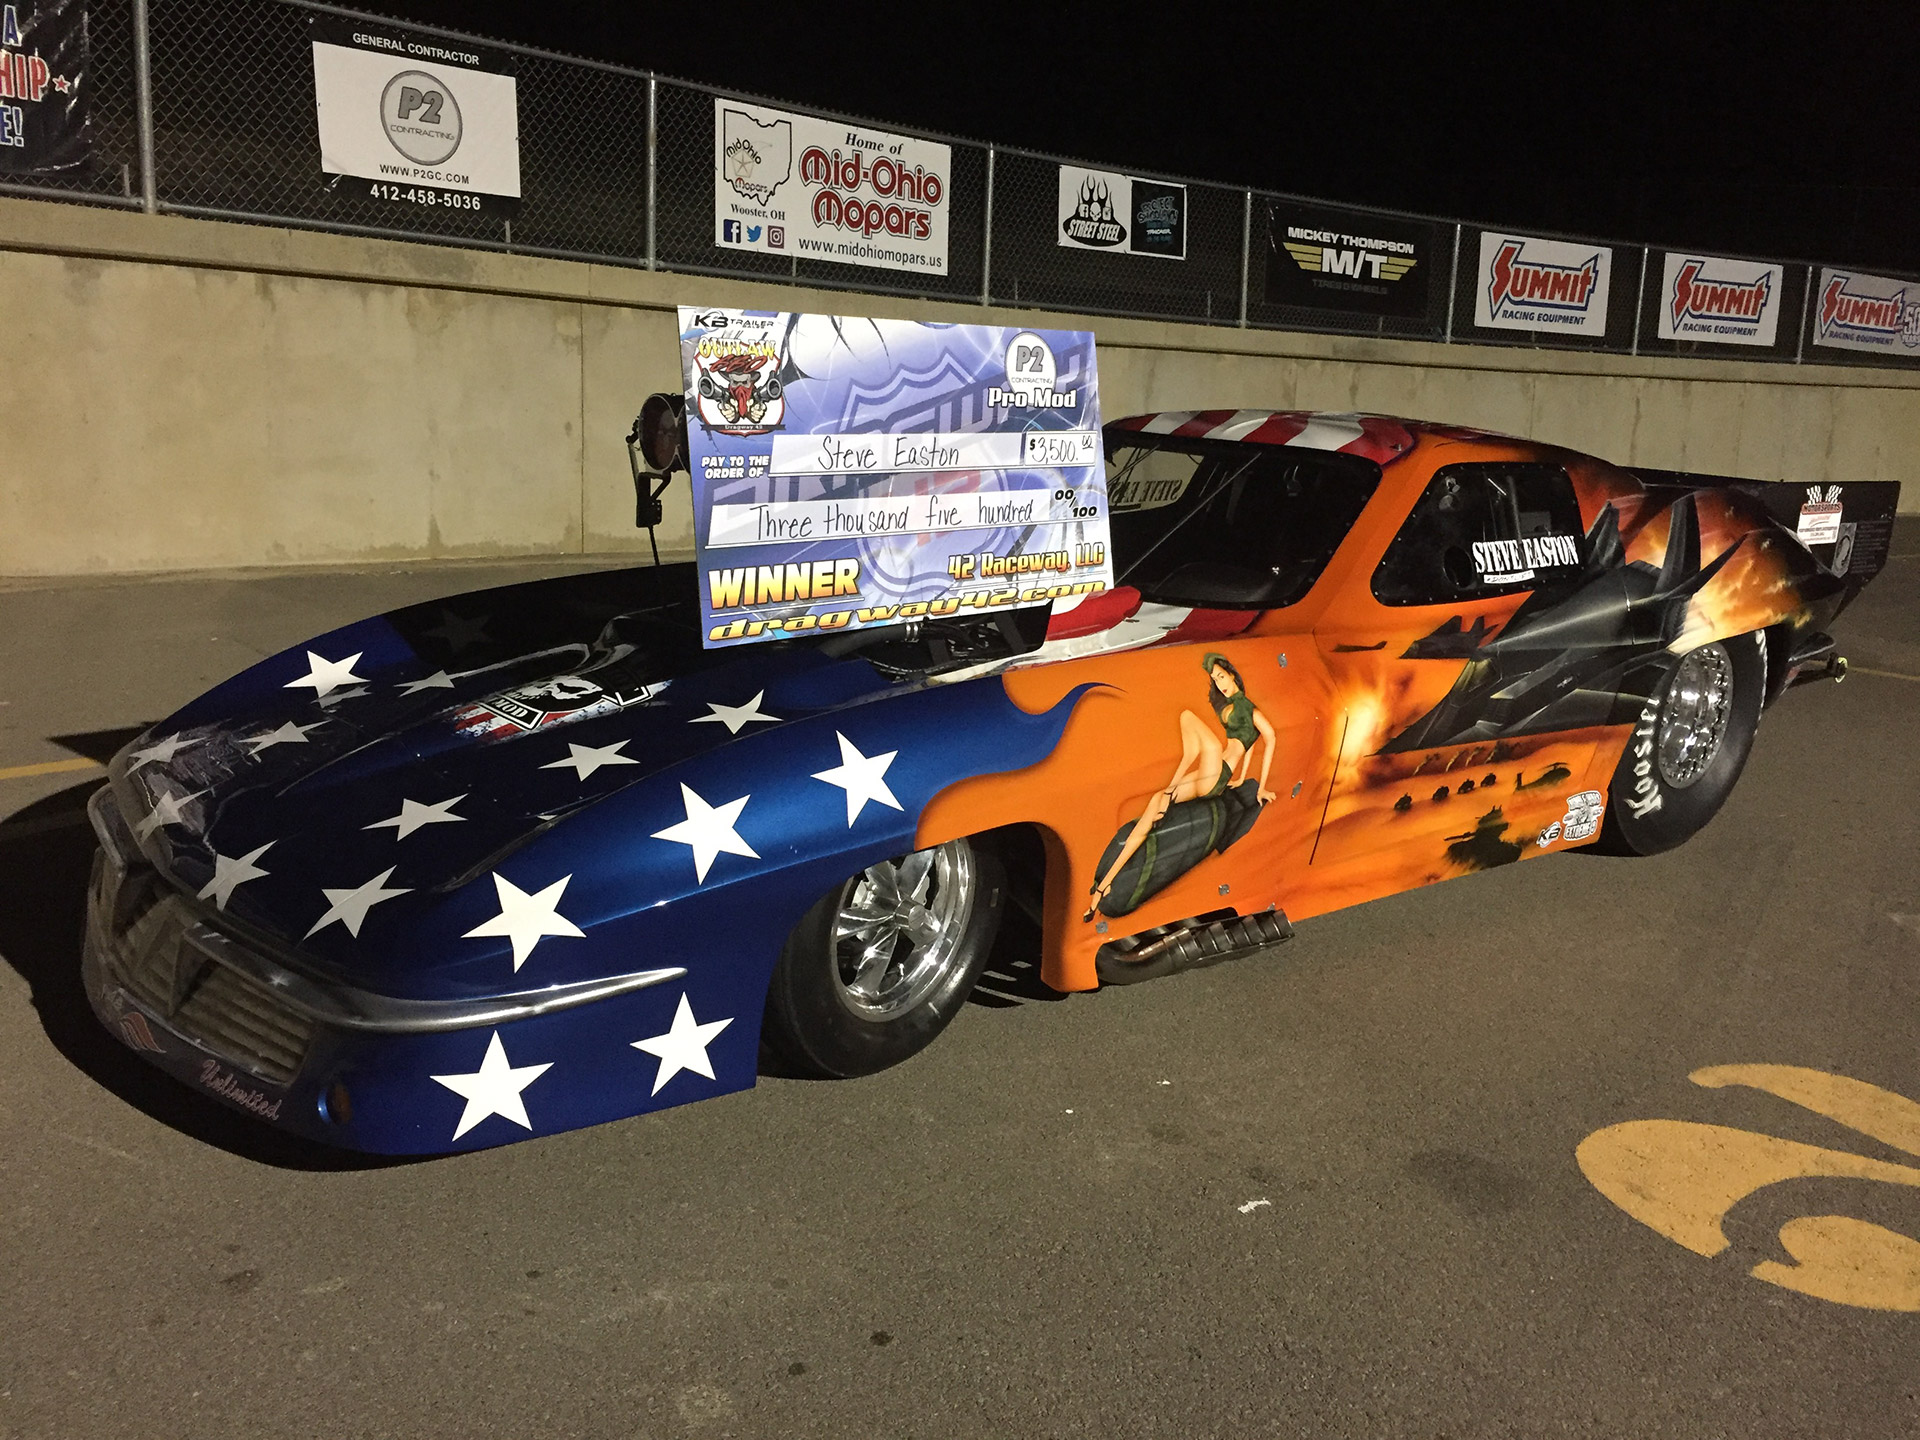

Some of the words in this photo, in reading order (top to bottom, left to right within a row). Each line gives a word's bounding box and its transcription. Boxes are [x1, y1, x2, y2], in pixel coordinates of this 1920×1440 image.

[3, 4, 22, 46] A
[353, 33, 406, 52] GENERAL
[407, 43, 480, 65] CONTRACTOR
[397, 86, 444, 124] P2
[390, 125, 455, 141] CONTRACTING
[845, 132, 884, 152] Home
[889, 143, 904, 155] of
[380, 164, 470, 184] WWW.P2GC.COM
[800, 147, 942, 206] Mid-Ohio
[370, 184, 481, 210] 412-458-5036
[770, 209, 785, 221] OH
[812, 189, 931, 240] Mopars
[1067, 219, 1099, 239] STREET
[1097, 222, 1120, 242] STEEL
[1288, 226, 1339, 244] MICKEY
[1341, 235, 1414, 254] THOMPSON
[798, 238, 942, 268] www.midohiomopars.us
[1321, 247, 1388, 279] M/T
[695, 315, 728, 328] KB
[731, 319, 774, 327] TRAILER
[1502, 310, 1535, 321] RACING
[1537, 312, 1586, 325] EQUIPMENT
[1682, 323, 1711, 333] RACING
[1714, 325, 1758, 336] EQUIPMENT
[699, 336, 776, 360] OUTLAW
[1829, 331, 1854, 342] RACING
[1856, 334, 1894, 345] EQUIPMENT
[1016, 345, 1044, 372] P2
[1011, 376, 1053, 385] CONTRACTING
[987, 387, 1028, 408] Pro
[1034, 387, 1077, 408] Mod
[701, 455, 726, 468] PAY
[729, 455, 745, 467] TO
[748, 455, 770, 466] THE
[818, 435, 877, 470] Steve
[894, 436, 960, 467] Easton
[704, 467, 745, 479] ORDER
[748, 467, 764, 478] OF
[750, 504, 812, 540] Three
[824, 503, 909, 534] thousand
[925, 494, 962, 527] five
[978, 495, 1034, 524] hundred
[948, 554, 976, 580] 42
[1075, 541, 1105, 567] LLC
[1472, 539, 1523, 573] STEVE
[1522, 535, 1579, 569] EASTON
[708, 558, 861, 610] WINNER
[708, 581, 1106, 641] dragway42.com
[1538, 827, 1561, 841] KB
[200, 1059, 282, 1121] Unlimited
